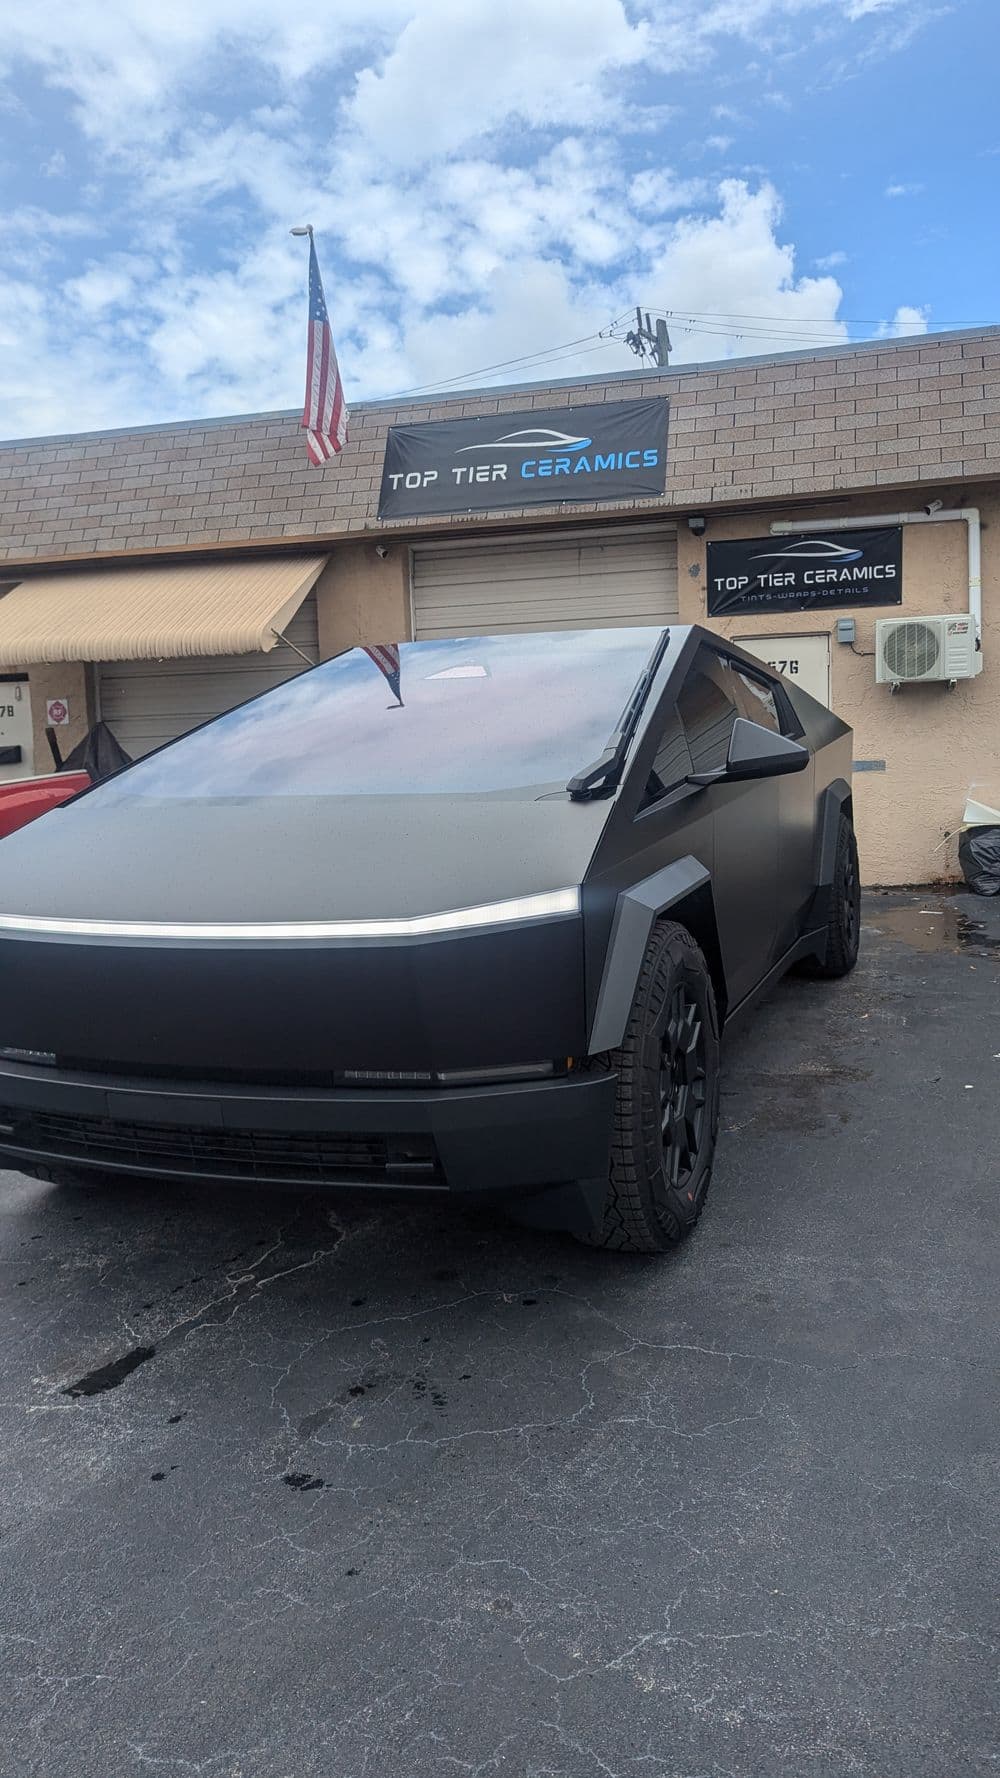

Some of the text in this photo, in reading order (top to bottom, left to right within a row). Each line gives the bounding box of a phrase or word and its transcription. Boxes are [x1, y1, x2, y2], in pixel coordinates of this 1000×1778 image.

[388, 449, 659, 490] TOP TIER CERAMICS
[714, 564, 896, 591] TOP TIER CERAMICS
